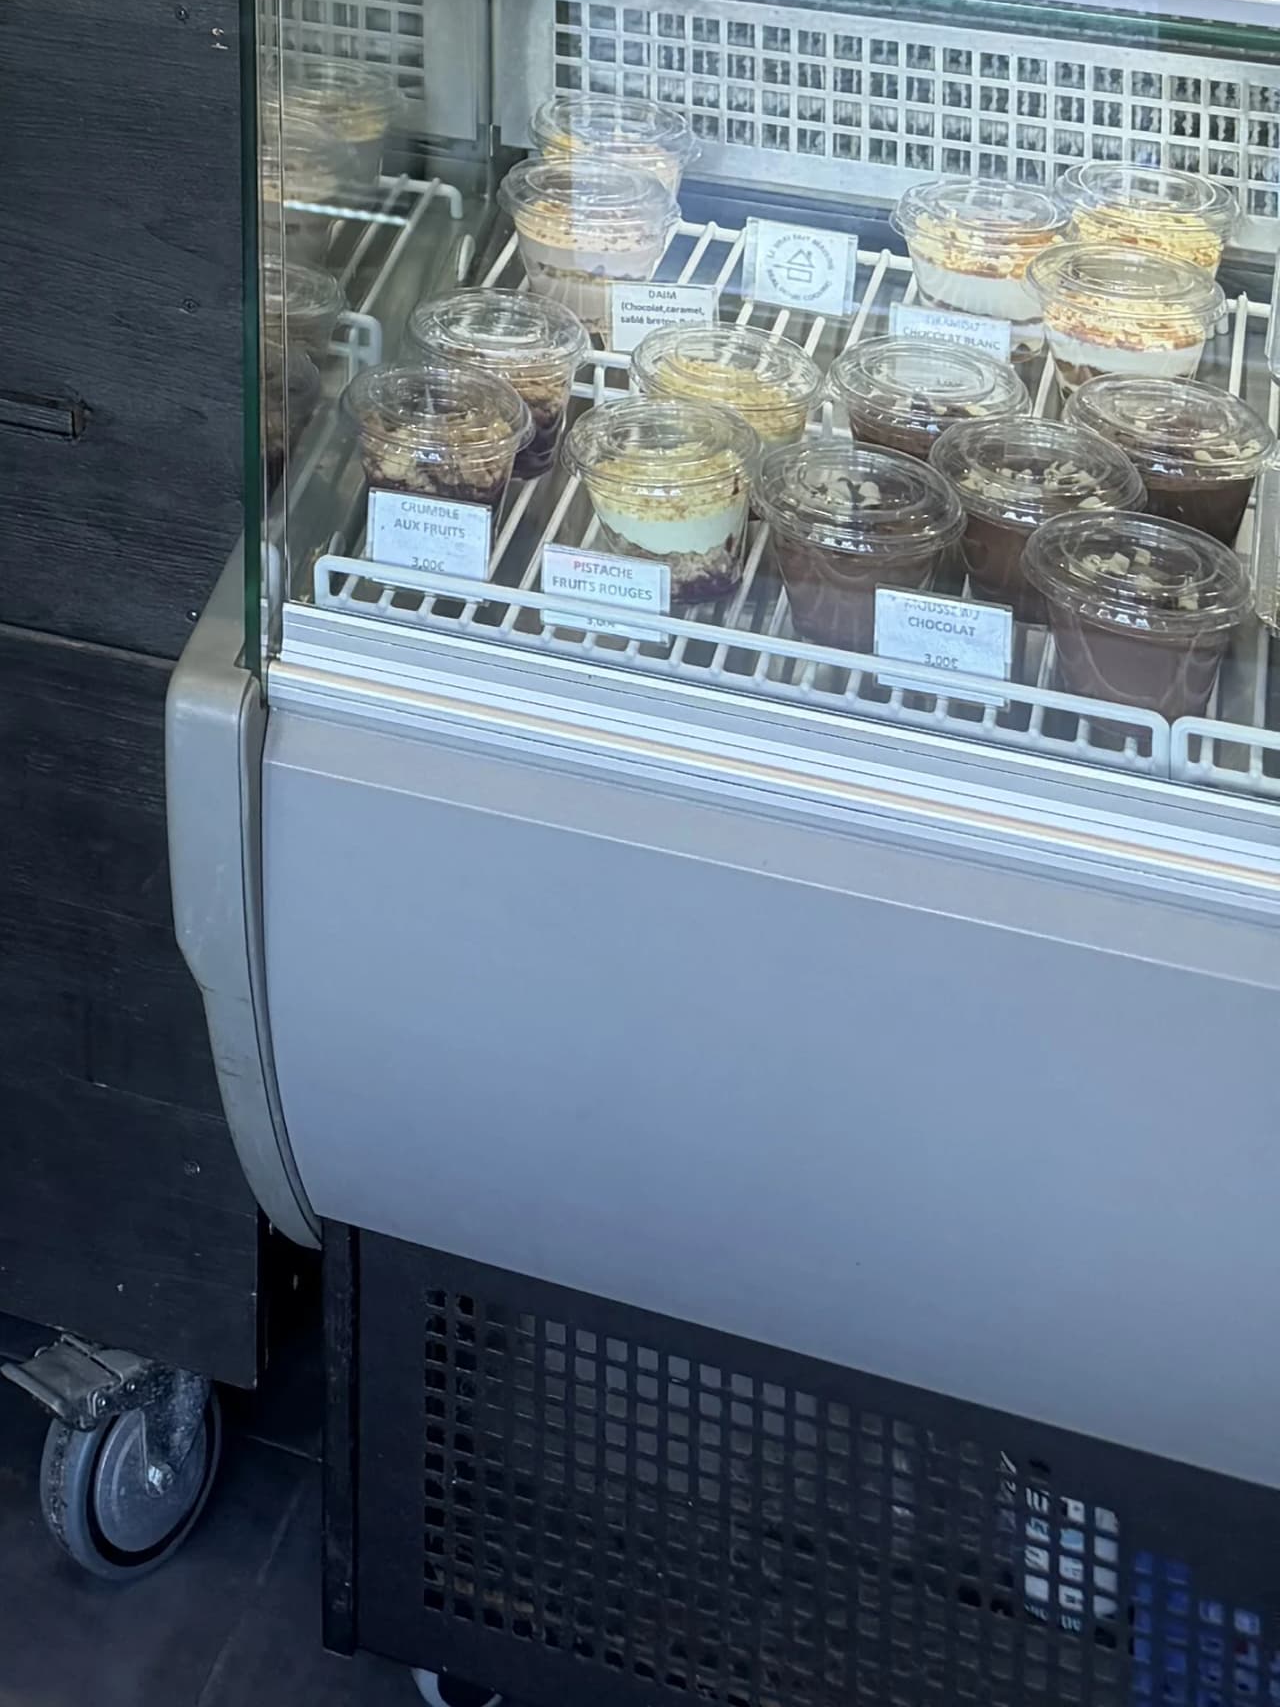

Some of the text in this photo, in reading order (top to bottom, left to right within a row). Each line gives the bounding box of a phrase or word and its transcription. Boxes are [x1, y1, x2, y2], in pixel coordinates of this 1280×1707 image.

[648, 289, 677, 300] DAIM
[963, 336, 1001, 351] BLANC
[393, 517, 466, 539] AUX FRUITS
[411, 556, 446, 573] 3,00€
[573, 560, 634, 580] PISTACHE
[552, 575, 653, 601] FRUITS ROUGES
[907, 616, 977, 637] CHOCOLAT
